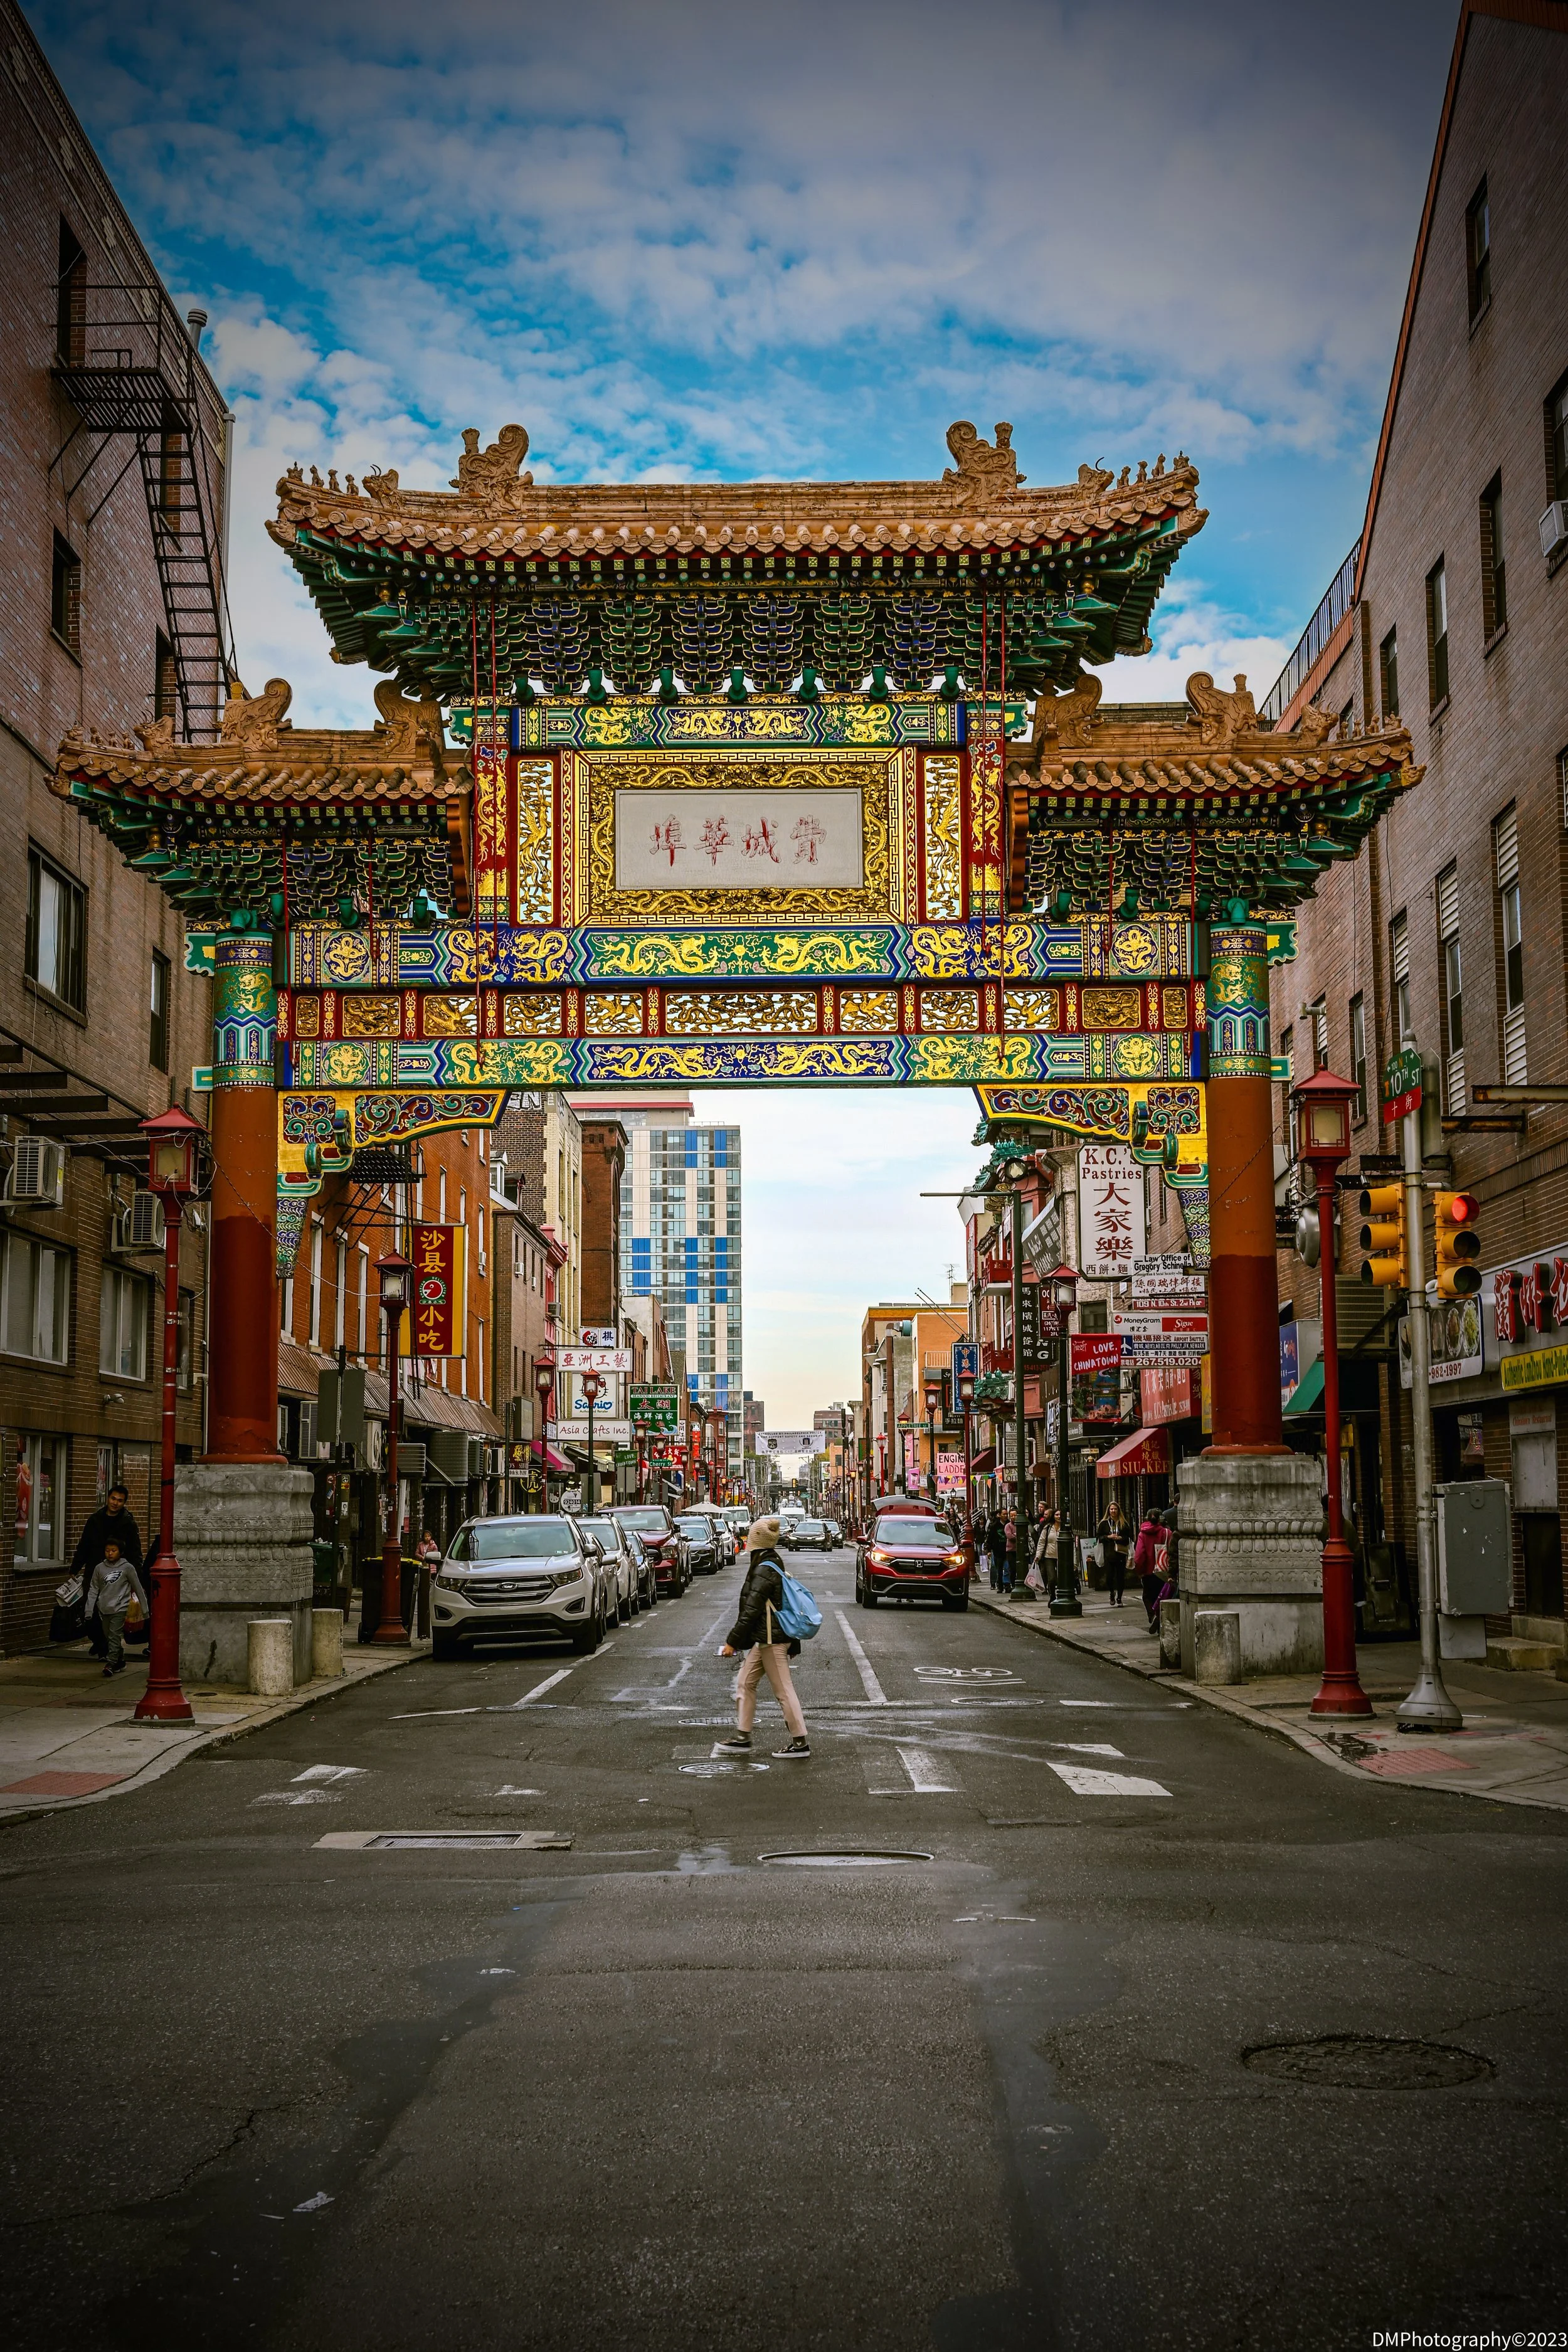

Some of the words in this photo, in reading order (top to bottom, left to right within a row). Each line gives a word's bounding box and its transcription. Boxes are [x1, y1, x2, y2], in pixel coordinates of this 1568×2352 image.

[1391, 1067, 1409, 1096] 10TH
[1412, 1067, 1419, 1086] ST
[1392, 1094, 1412, 1117] 十街
[1082, 1167, 1142, 1179] Pastries
[1093, 1182, 1133, 1261] 大家樂
[1086, 1264, 1128, 1275] 西餅·麵
[1134, 1263, 1160, 1272] Gregory
[1163, 1261, 1192, 1269] Schinella
[1175, 1319, 1193, 1328] Sigue
[1074, 1353, 1119, 1371] CHINATOWN
[575, 1399, 613, 1411] Sario
[559, 1426, 580, 1434] Asia
[583, 1424, 610, 1437] Cafts
[939, 1454, 965, 1463] ENGIN
[939, 1465, 964, 1473] LADDE
[1123, 1461, 1140, 1474] SIU
[1147, 1461, 1170, 1473] KEE
